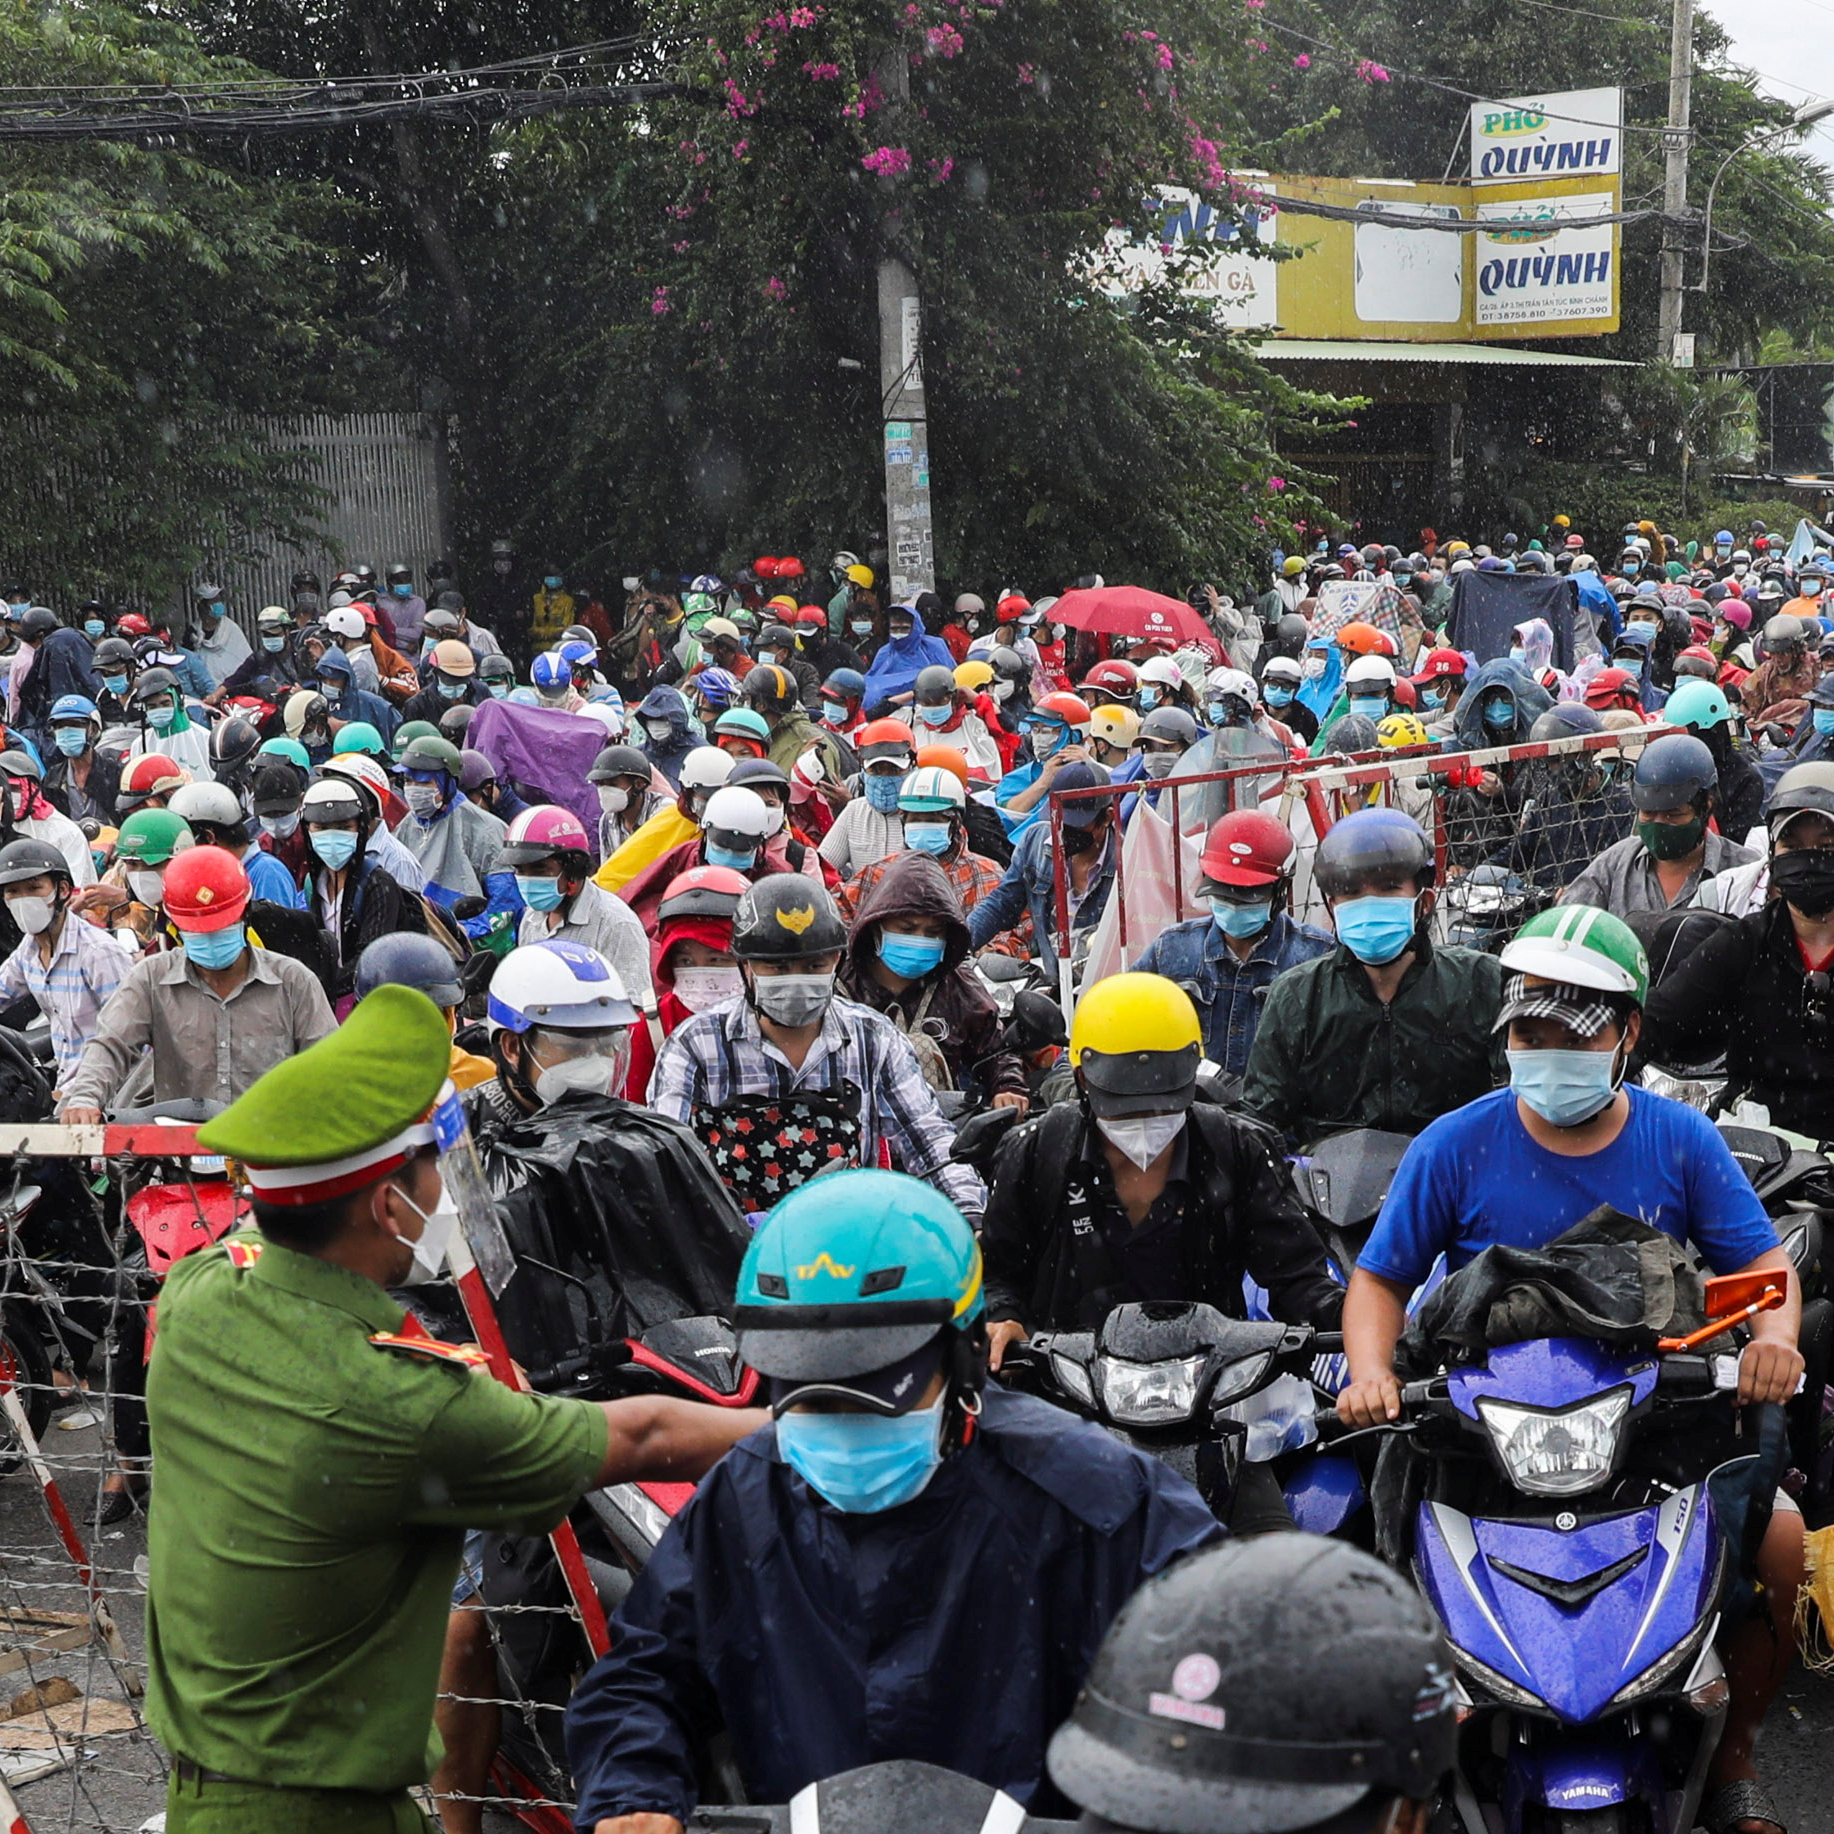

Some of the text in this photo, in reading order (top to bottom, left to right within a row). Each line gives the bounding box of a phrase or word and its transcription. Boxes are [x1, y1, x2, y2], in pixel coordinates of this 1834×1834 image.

[1480, 135, 1612, 178] QUỲNH
[1226, 265, 1255, 291] GÀ
[1479, 246, 1610, 297] QUỲNH
[1436, 661, 1449, 672] 26
[1730, 1150, 1766, 1164] HONDA
[694, 1346, 731, 1358] HONDA
[1673, 1497, 1689, 1535] 150
[1561, 1784, 1610, 1801] YAMAHA
